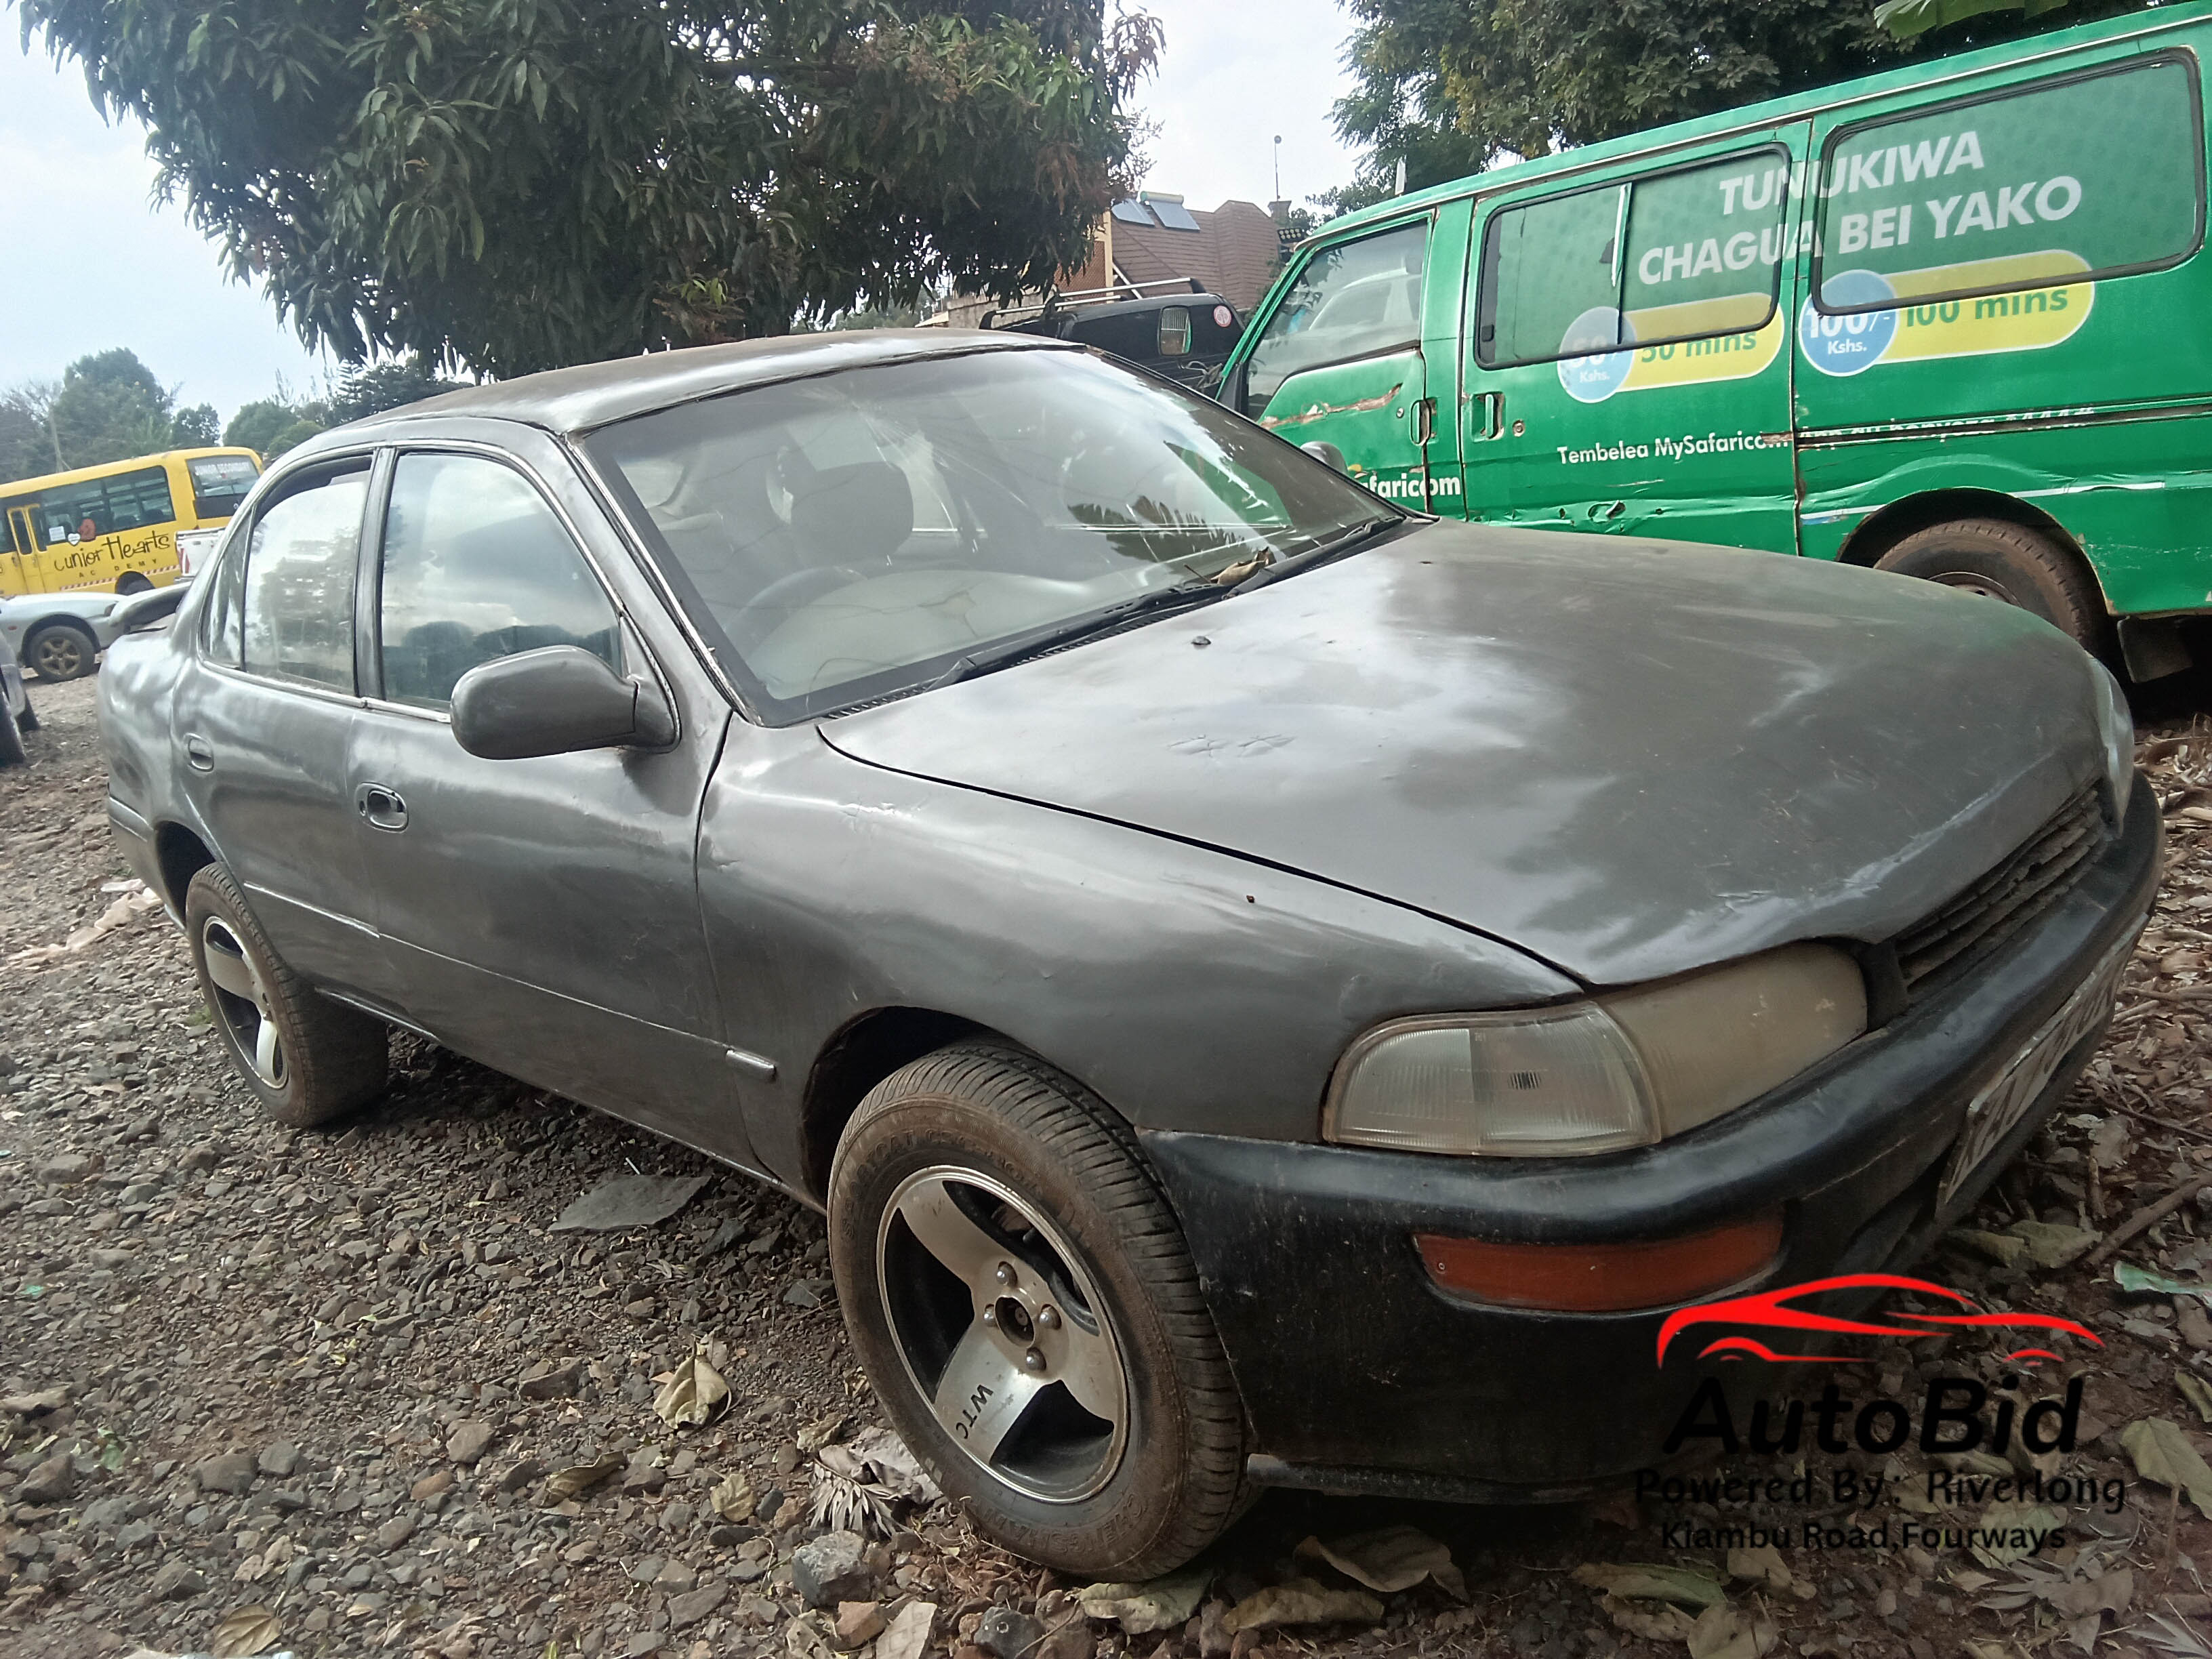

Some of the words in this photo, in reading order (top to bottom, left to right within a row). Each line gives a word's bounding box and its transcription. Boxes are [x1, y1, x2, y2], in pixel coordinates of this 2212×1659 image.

[1719, 131, 1984, 216] TUNUKIWA
[1639, 220, 1824, 285] CHAGUA
[1838, 205, 1912, 254] BEI
[1925, 176, 2082, 239] YAKO
[1974, 289, 2068, 319] mins
[1686, 332, 1757, 357] mins
[1828, 338, 1867, 355] Kshs.
[1557, 441, 1649, 464] Tembelea
[1655, 431, 1788, 460] MySafarico
[102, 531, 169, 560] Hearts
[956, 1385, 994, 1439] WTC
